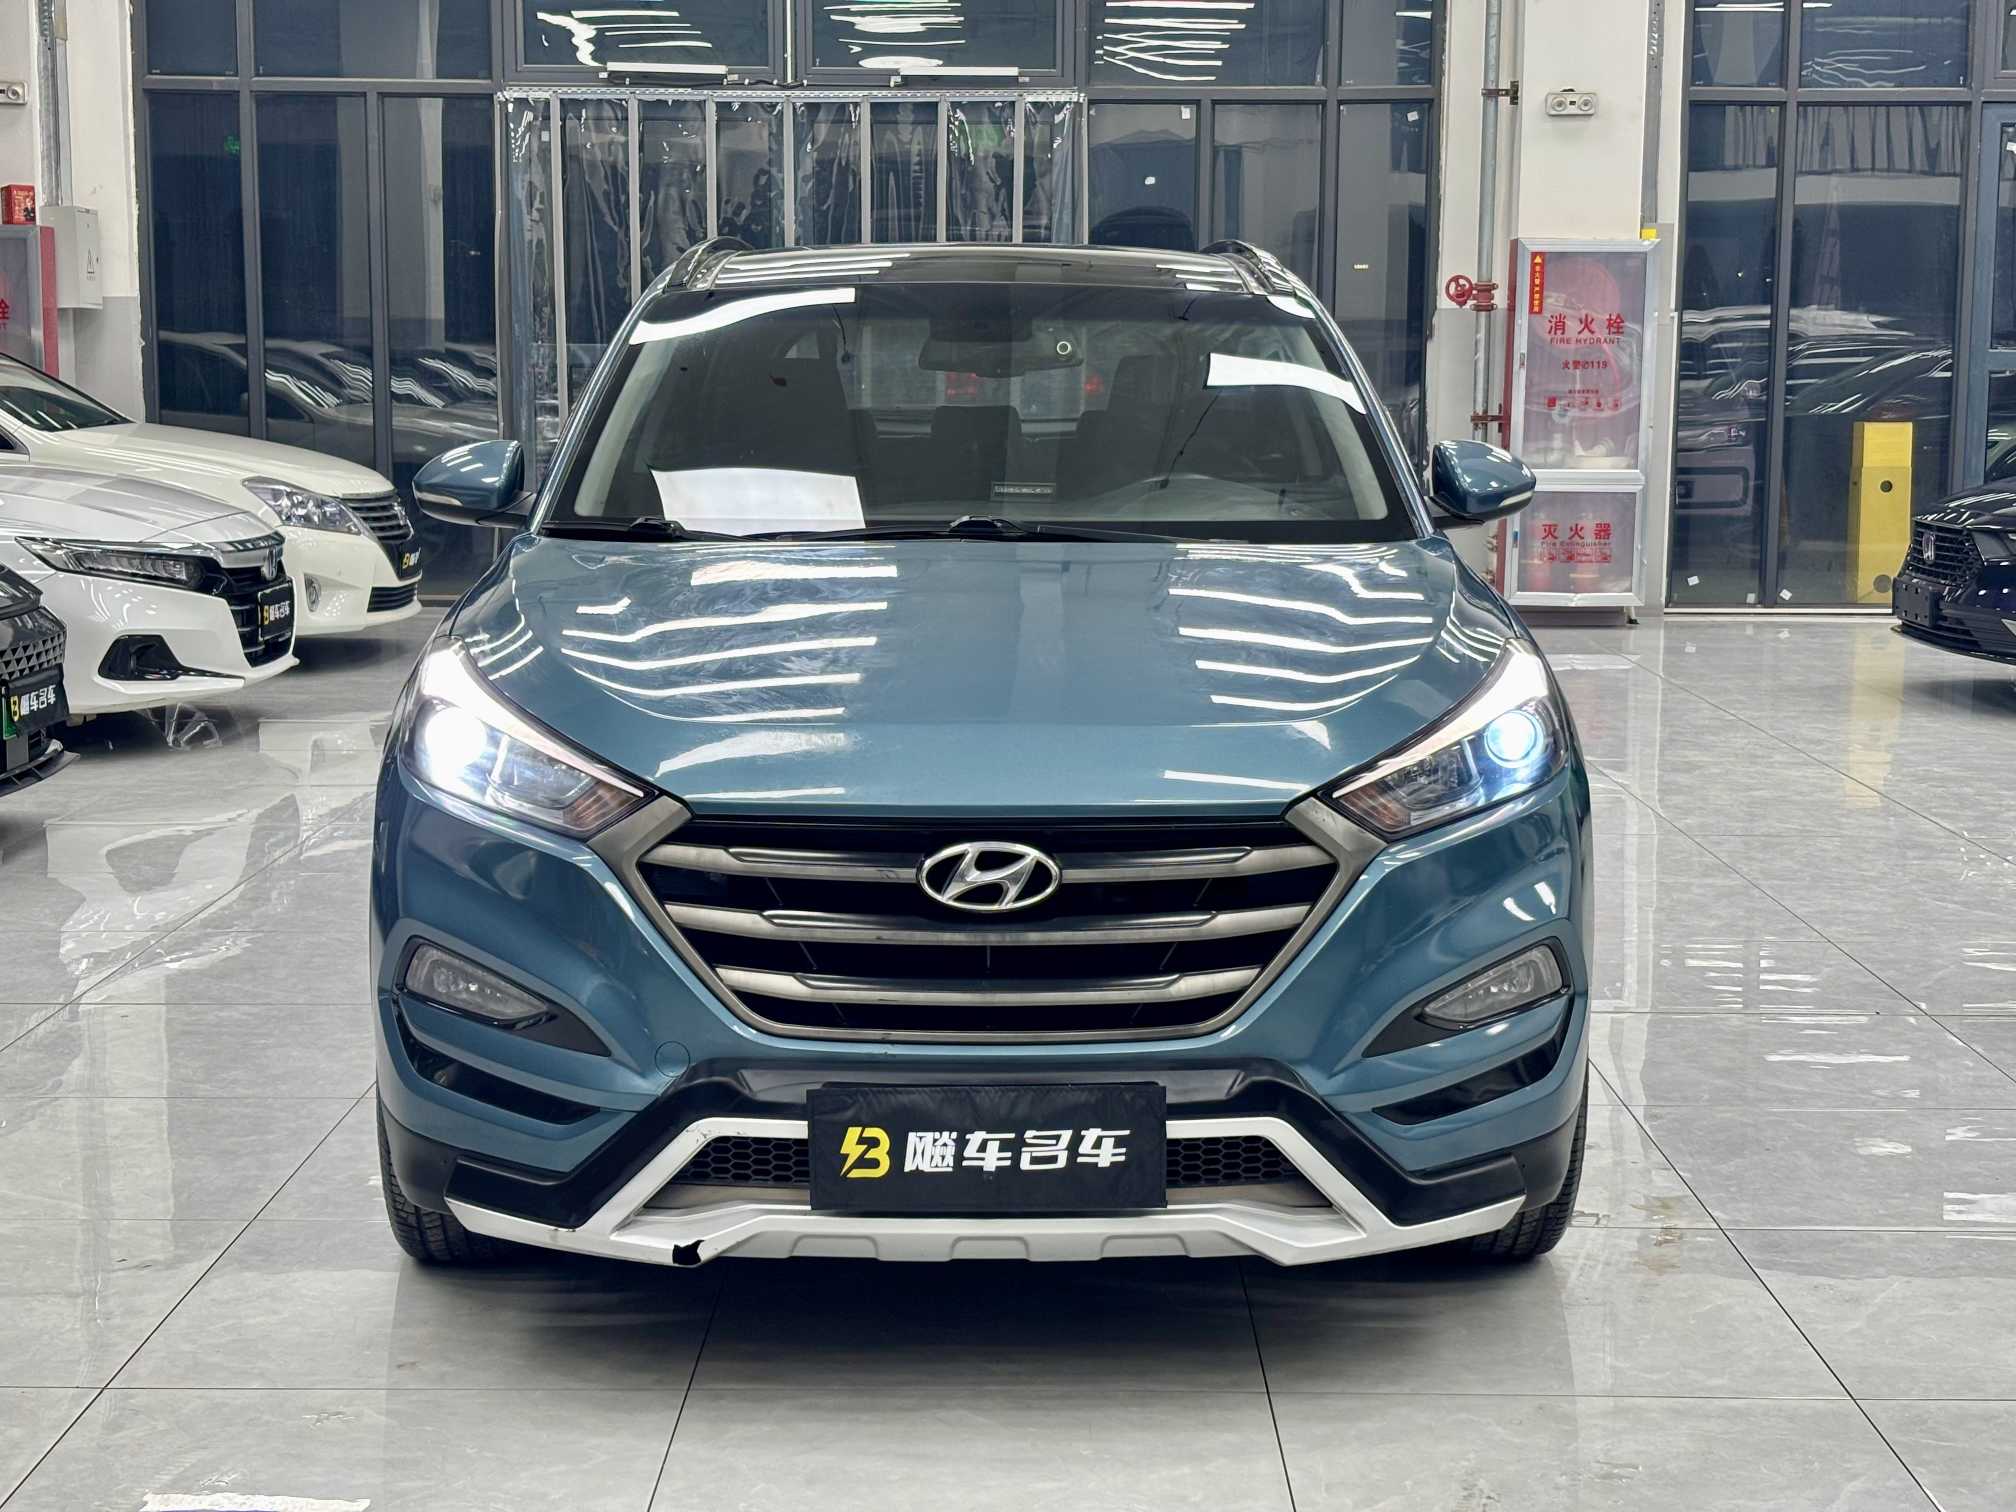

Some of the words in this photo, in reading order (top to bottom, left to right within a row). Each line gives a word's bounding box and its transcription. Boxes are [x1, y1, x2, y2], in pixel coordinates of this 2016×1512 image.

[1548, 313, 1625, 336] 消火栓
[1550, 337, 1571, 345] FIRE
[1575, 337, 1622, 345] HYDRANT
[1541, 523, 1612, 540] 灭火器
